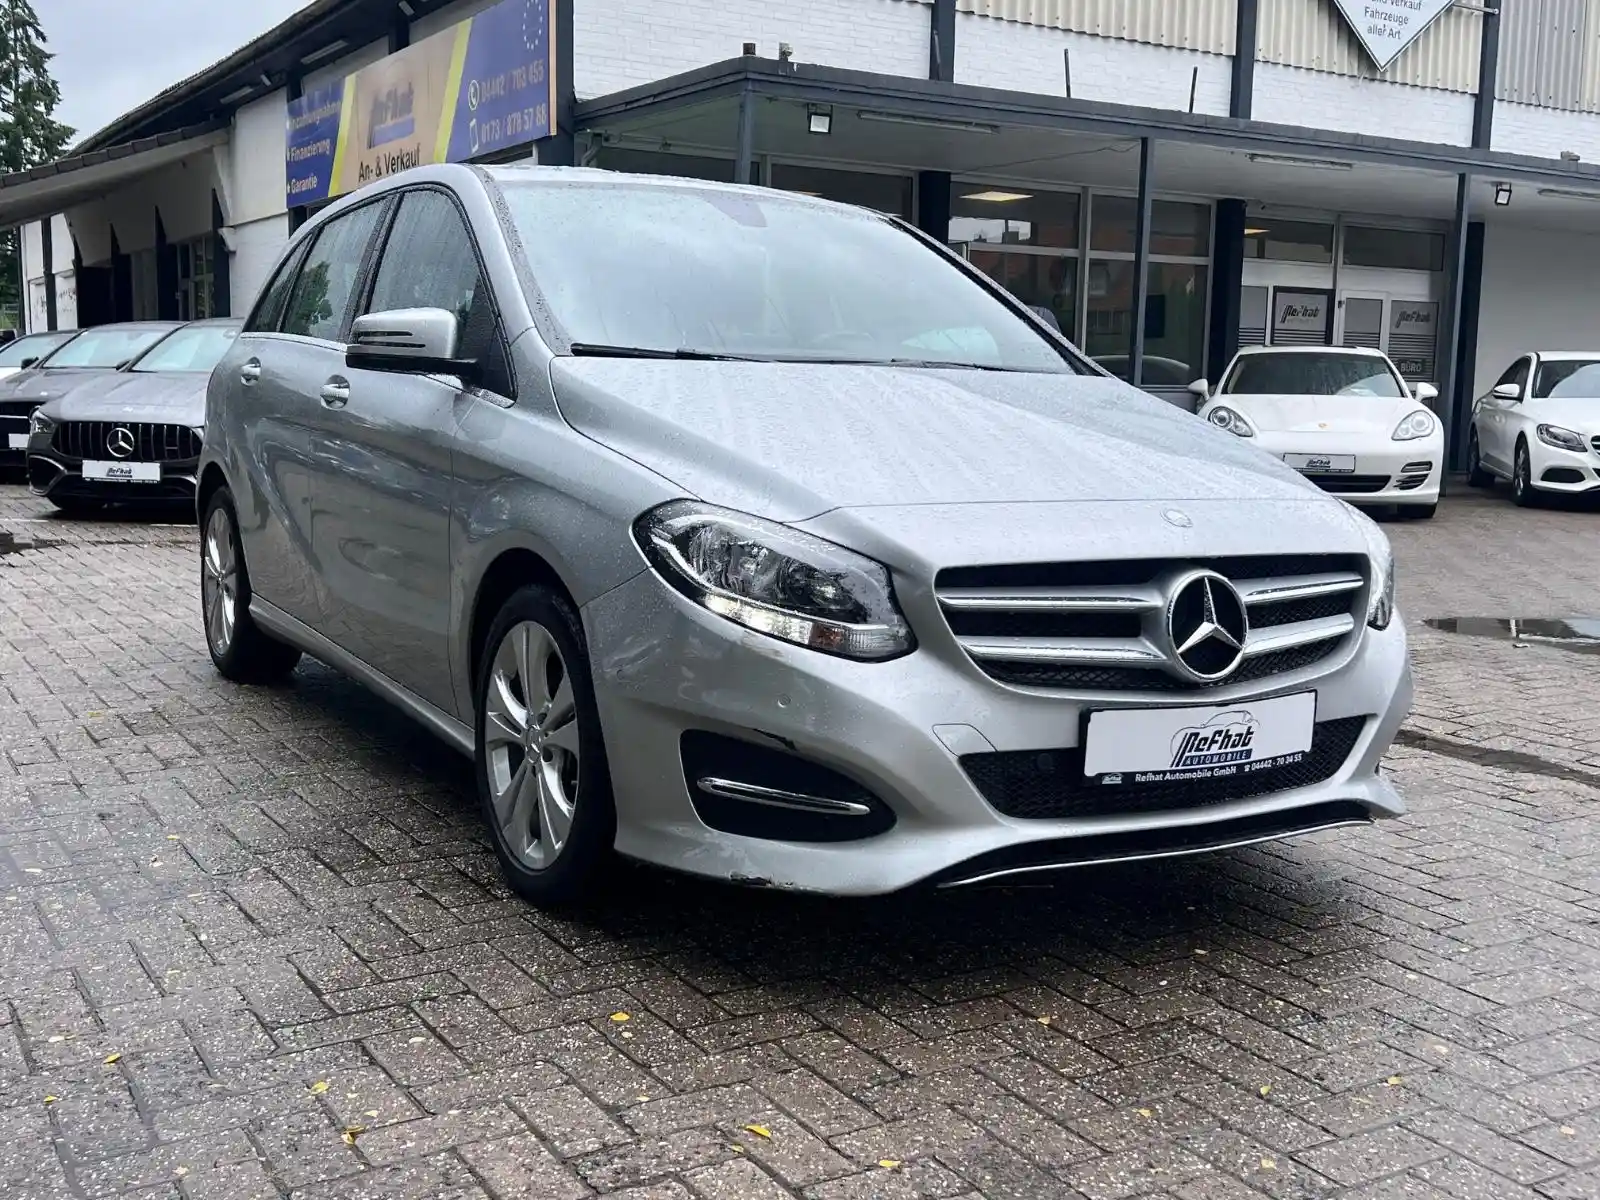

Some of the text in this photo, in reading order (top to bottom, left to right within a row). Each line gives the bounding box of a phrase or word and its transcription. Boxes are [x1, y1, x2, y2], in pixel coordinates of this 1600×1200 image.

[1364, 6, 1409, 26] Fahrzeuge
[1367, 24, 1401, 39] aller Art
[523, 107, 534, 131] 57
[291, 139, 330, 161] Finanzierung
[359, 142, 420, 182] An- & Verkauf
[292, 173, 318, 194] Garantie
[1135, 772, 1163, 782] Refhat
[1164, 768, 1212, 781] Automobile
[1213, 765, 1237, 777] GmbH
[1251, 760, 1272, 771] 04442
[1276, 757, 1284, 766] 70
[1285, 755, 1293, 764] 34
[1293, 753, 1303, 762] 55
[1185, 753, 1247, 766] AUTOMOBILE
